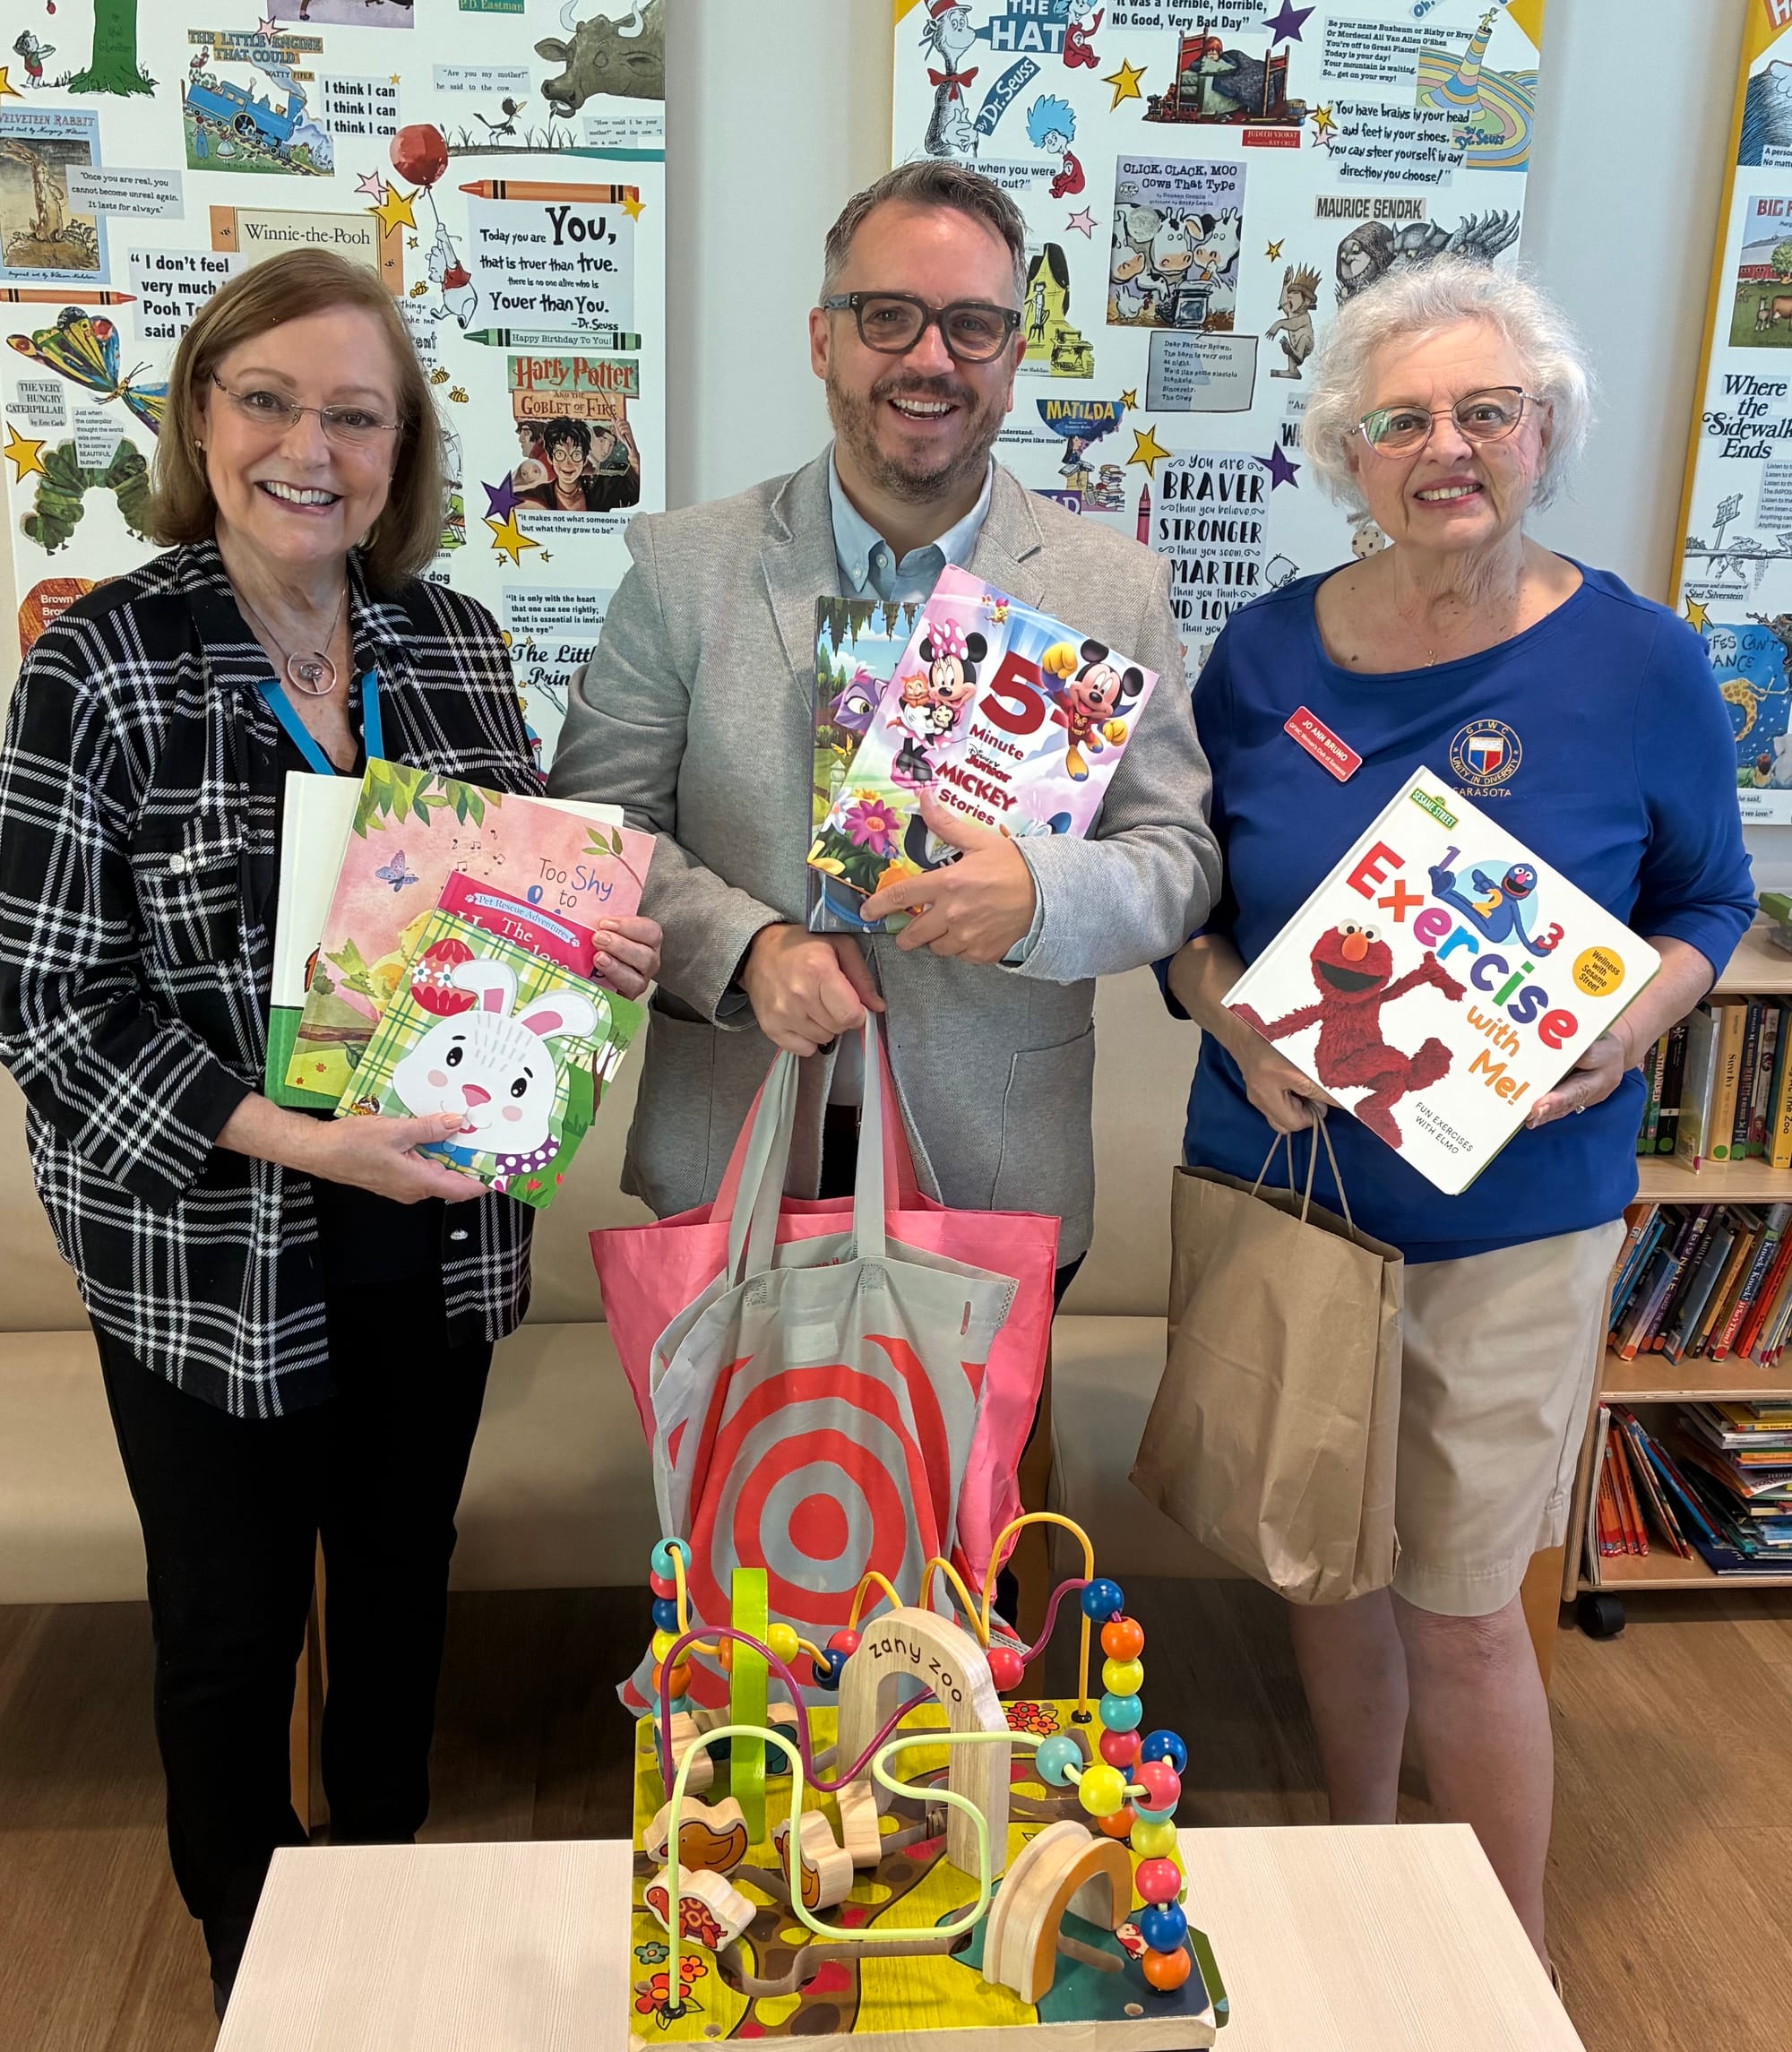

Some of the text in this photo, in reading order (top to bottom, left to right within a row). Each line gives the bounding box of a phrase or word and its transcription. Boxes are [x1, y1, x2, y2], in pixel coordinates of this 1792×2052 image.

[481, 0, 524, 11] Eastman
[1008, 0, 1048, 15] THE
[1167, 0, 1267, 13] Terrible, Horrible,
[1113, 13, 1128, 25] NO
[1132, 13, 1164, 29] Good,
[1168, 14, 1193, 30] Very
[1197, 15, 1218, 28] Bad
[188, 31, 323, 51] THE LITTLE ENGINE
[992, 20, 1066, 52] HAT
[214, 48, 296, 64] THAT COULD
[464, 71, 492, 79] you my
[996, 59, 1036, 99] Seuss
[324, 81, 395, 98] I think I can
[325, 99, 396, 116] I think I can
[1356, 103, 1469, 125] have brains in your head
[0, 113, 96, 131] VELVETEEN RABBIT
[326, 119, 396, 135] I think I can
[1342, 123, 1359, 135] and
[1362, 123, 1383, 138] feet
[1383, 126, 1393, 138] in
[1393, 129, 1415, 143] your
[1477, 128, 1505, 145] Seuss
[1329, 142, 1464, 167] you can steer yourself in any
[1123, 163, 1237, 177] CLICK, CLACK, MOO
[1340, 162, 1383, 179] direction
[1384, 169, 1400, 182] you
[1142, 178, 1236, 193] Cows That Type
[1316, 198, 1423, 220] MAURICE SENDAK
[1757, 200, 1783, 216] BIG
[245, 223, 370, 245] Winnie-the-Pooh
[479, 205, 616, 246] Today you are You,
[156, 255, 229, 272] don’t feel
[479, 252, 618, 272] that is truer than true.
[141, 280, 217, 297] very much
[143, 300, 181, 315] Pooh
[489, 292, 609, 314] Youer than You.
[145, 323, 176, 338] said
[513, 333, 538, 344] Happy
[541, 334, 578, 345] Birthday
[580, 336, 590, 344] To
[513, 357, 633, 390] Harry Potter
[20, 384, 62, 392] THE VERY
[1724, 374, 1787, 396] Where
[27, 394, 62, 403] HUNGRY
[521, 396, 617, 418] GOBLET OF FIRE
[1737, 396, 1769, 418] the
[5, 404, 65, 415] CATERPILLAR
[1047, 401, 1116, 420] MATILDA
[1719, 438, 1772, 459] Ends
[1219, 458, 1245, 470] are
[1163, 470, 1264, 503] BRAVER
[1176, 503, 1215, 516] than you
[1159, 518, 1262, 544] STRONGER
[1176, 544, 1217, 557] than you
[1170, 559, 1260, 586] MARTER
[40, 594, 73, 604] Brown
[1705, 588, 1744, 600] Silverstein
[511, 643, 549, 662] The
[969, 723, 1024, 761] Minute
[1302, 720, 1348, 762] JO ANN BRUNO
[965, 754, 1012, 783] Junior
[1452, 755, 1519, 785] UNITY IN DIVERSITY
[935, 761, 1018, 812] MICKEY
[939, 788, 995, 826] Stories
[1412, 789, 1457, 827] SESAME STREET
[1439, 846, 1460, 870] 1
[539, 858, 614, 902] Too Shy
[559, 890, 577, 908] to
[1472, 888, 1503, 918] 2
[478, 895, 570, 940] Pet Rescue Adventures
[502, 917, 533, 943] The
[1538, 922, 1564, 950] 3
[1346, 841, 1578, 1049] Exercise
[1592, 950, 1620, 976] Wellness
[1592, 961, 1607, 976] with
[1579, 973, 1599, 992] Street
[1581, 964, 1607, 987] Sesame
[1467, 1005, 1520, 1057] with
[1468, 1048, 1530, 1105] Me!
[1416, 1101, 1473, 1151] FUN EXERCISES
[1416, 1116, 1459, 1153] WITH ELMO
[868, 1638, 961, 1703] zany zoo
